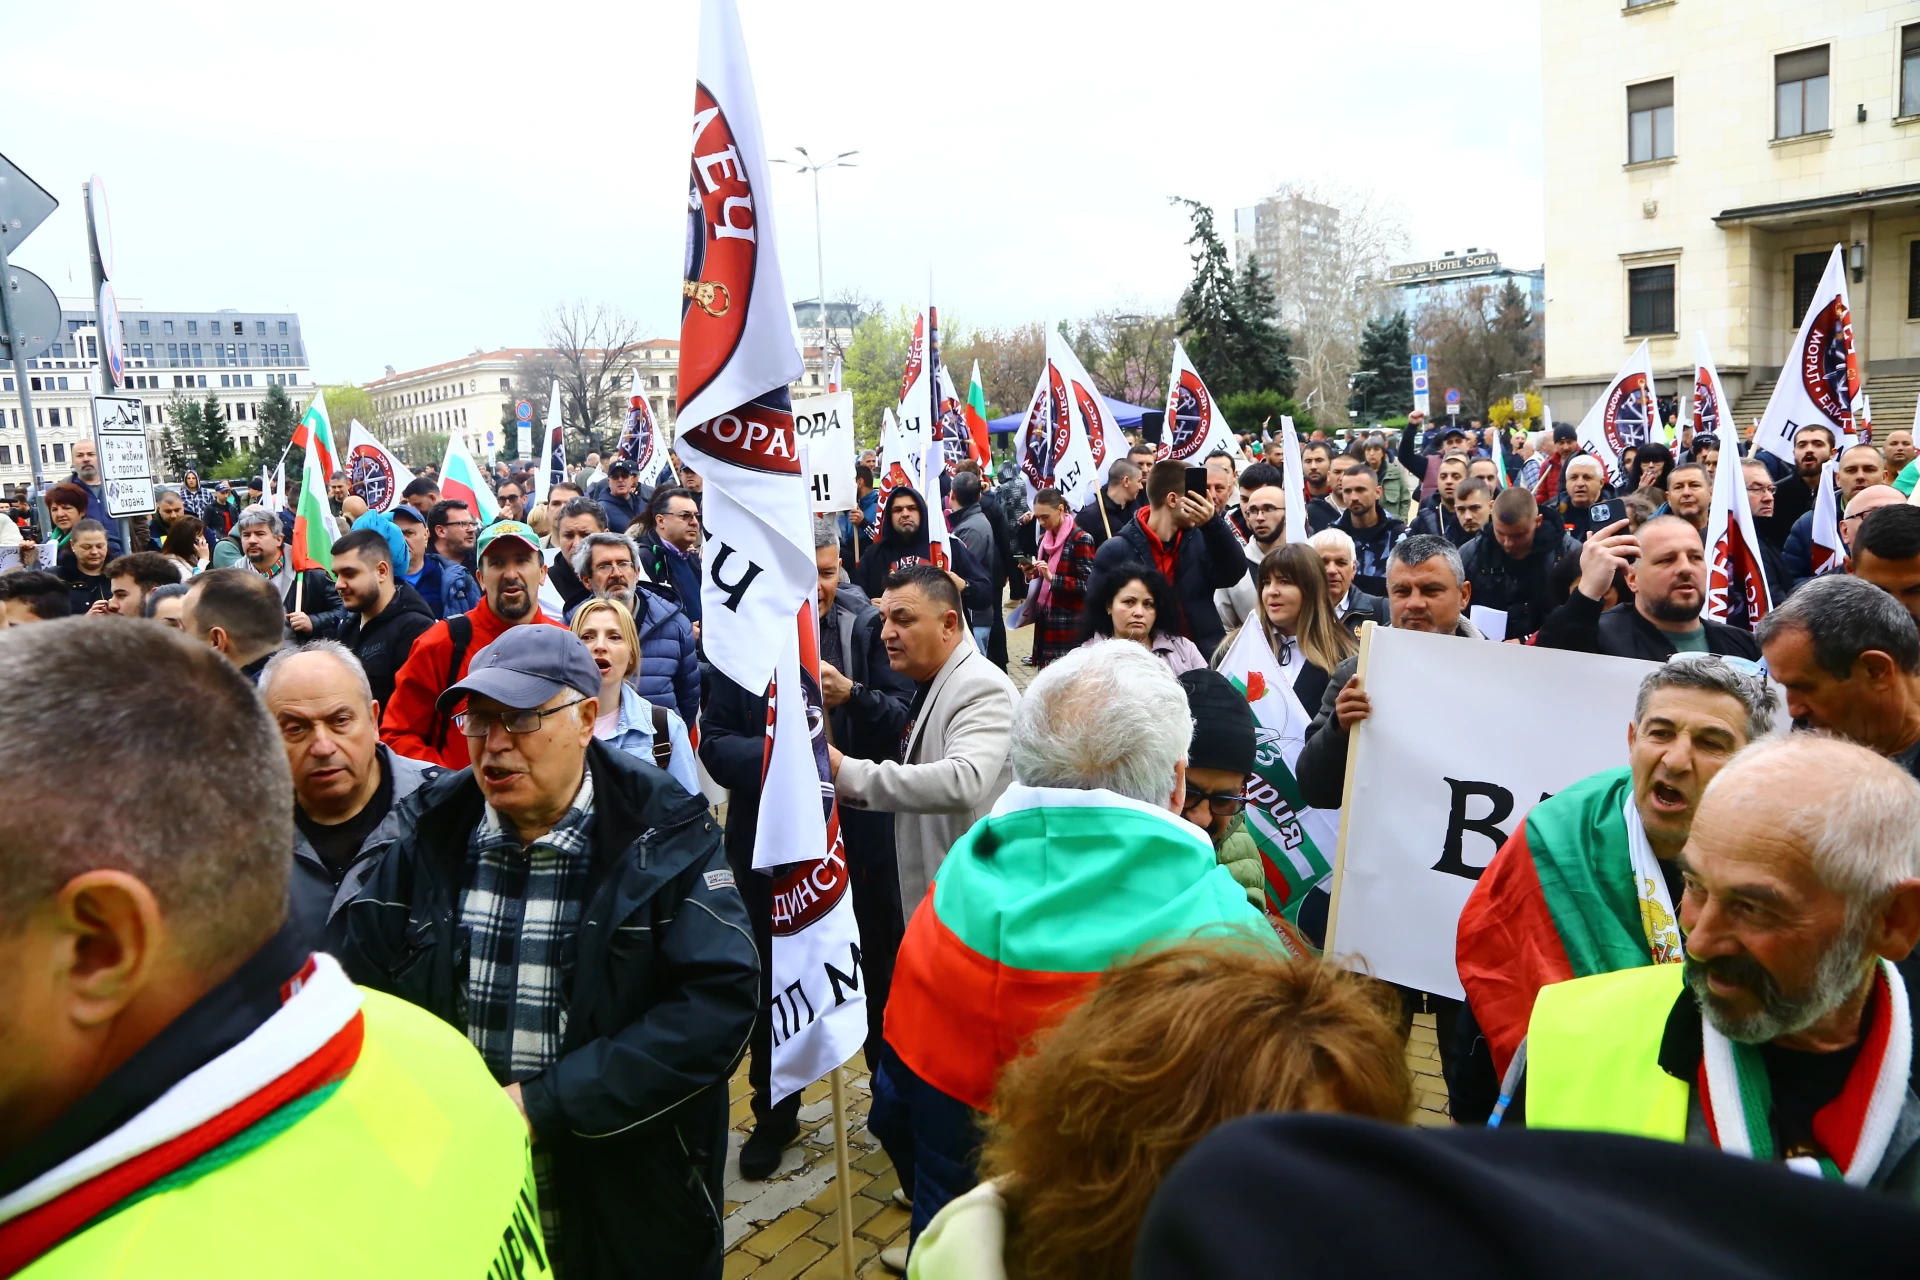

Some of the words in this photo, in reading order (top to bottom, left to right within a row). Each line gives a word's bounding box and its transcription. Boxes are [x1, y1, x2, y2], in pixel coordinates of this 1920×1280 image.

[1429, 260, 1463, 272] HOTEL
[1466, 255, 1497, 267] SOFIA
[1805, 329, 1824, 384] МОРАЛ
[1055, 385, 1069, 417] ЧЕСТ
[1196, 386, 1208, 411] ЧЕСТ
[1606, 387, 1623, 423] МОРАЛ
[796, 409, 841, 439] ОДА
[1171, 419, 1208, 459] ЕДИНСТВО
[376, 453, 390, 471] ЧЕСТ
[120, 497, 145, 510] охрана
[374, 477, 393, 512] ЕДИНСТВО
[772, 824, 846, 927] ДИНСТ
